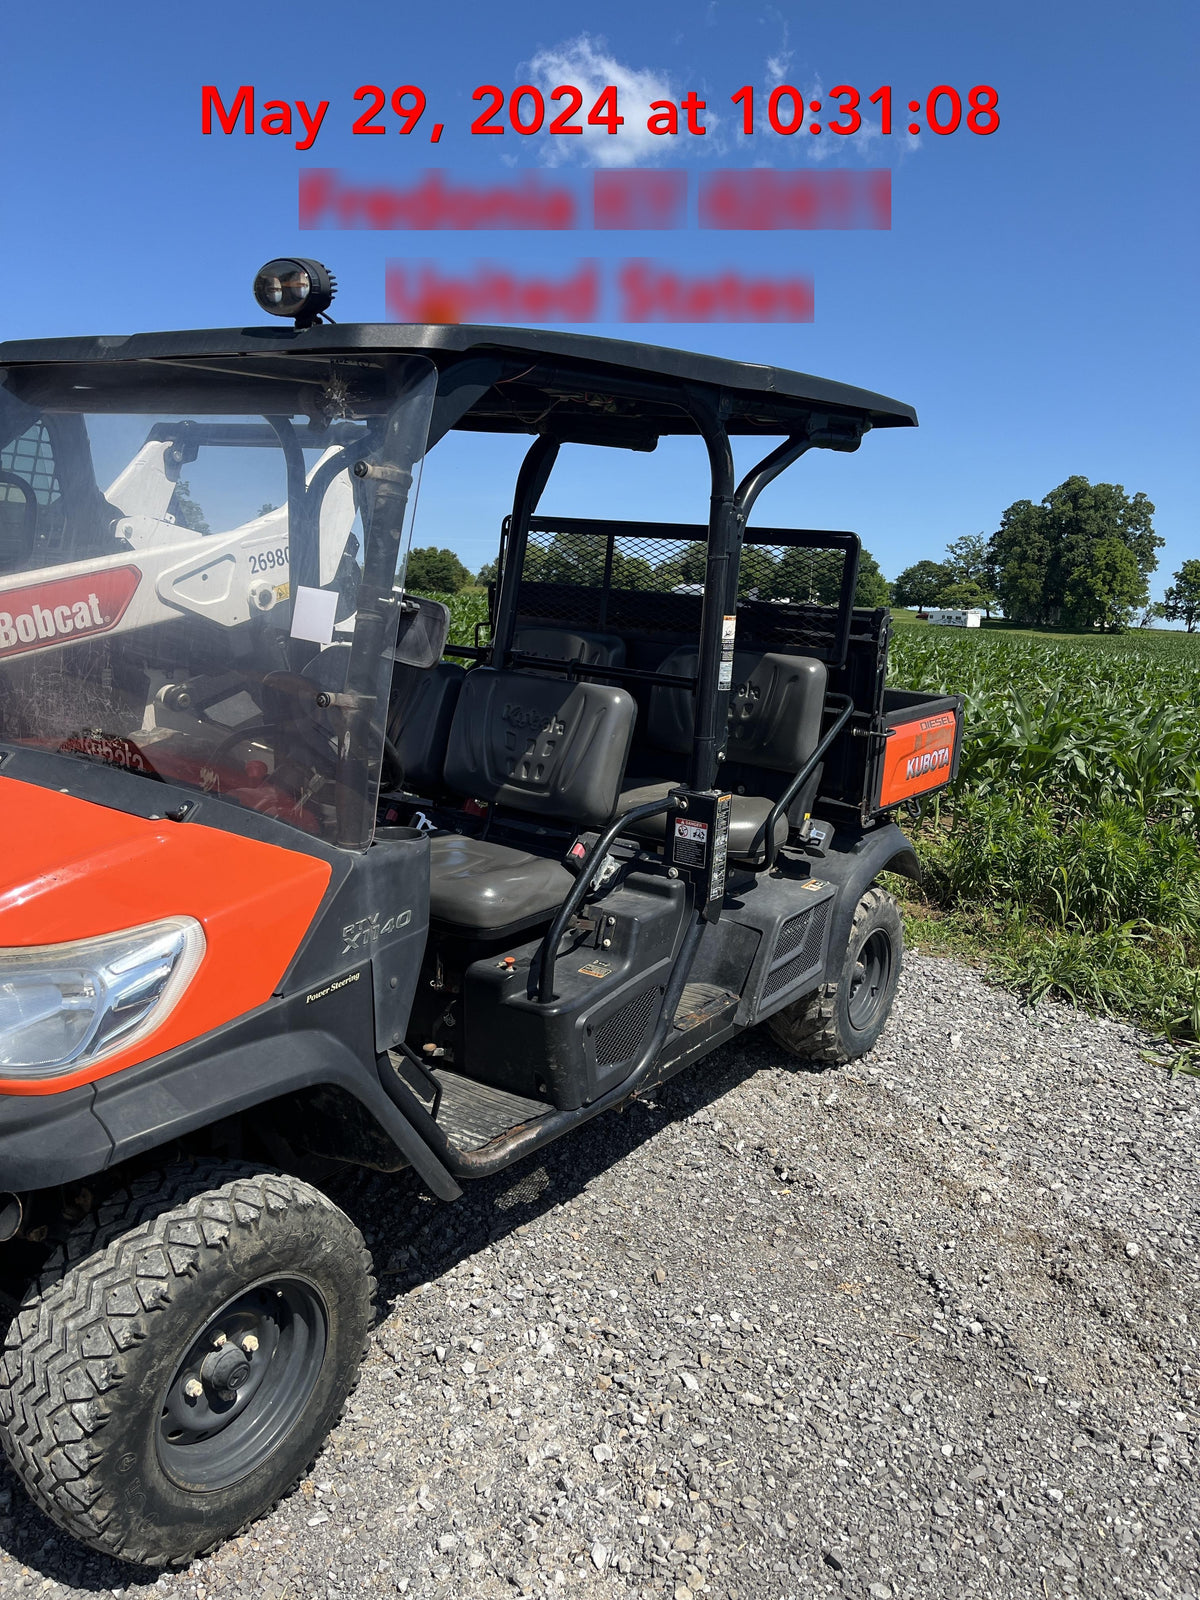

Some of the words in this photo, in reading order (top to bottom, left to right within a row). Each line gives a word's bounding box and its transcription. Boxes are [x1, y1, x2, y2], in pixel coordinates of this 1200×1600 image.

[0, 592, 104, 649] Bobcat
[920, 716, 954, 731] DIESEL
[906, 747, 949, 780] KUBOTA
[341, 909, 412, 955] X1140
[342, 912, 380, 938] RTV
[306, 986, 331, 1004] Power
[330, 972, 361, 993] Steering
